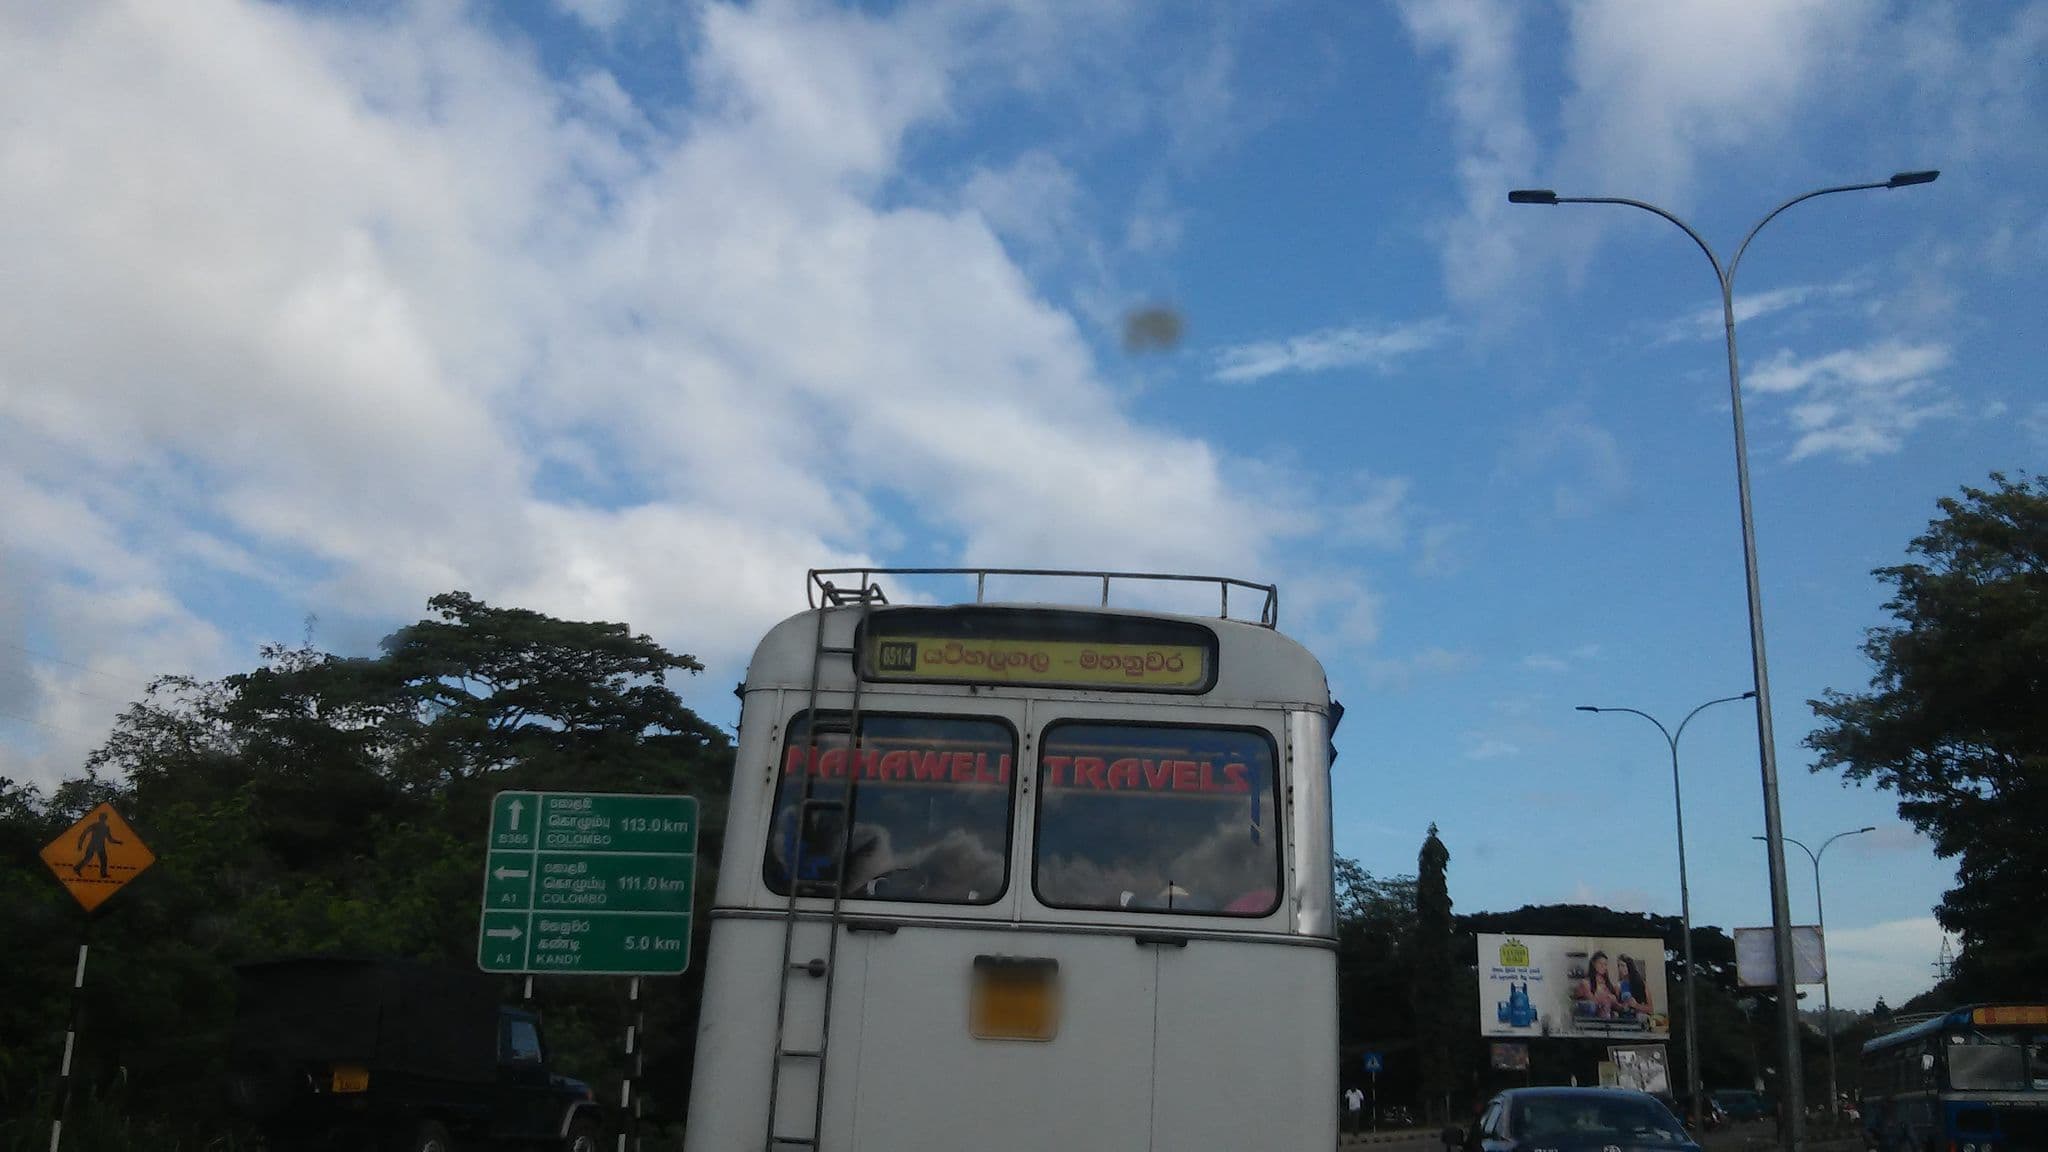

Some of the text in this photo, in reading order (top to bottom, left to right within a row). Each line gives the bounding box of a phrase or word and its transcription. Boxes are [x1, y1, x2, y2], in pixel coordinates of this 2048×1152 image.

[1079, 649, 1184, 677] මහනුවර
[1043, 755, 1250, 793] TRAVELS
[549, 814, 611, 830] கொழும்பு
[547, 834, 612, 845] COLOMBO
[543, 876, 608, 892] கொழும்பு
[501, 893, 517, 904] A1
[542, 893, 608, 904] COLOMBO
[624, 935, 681, 951] 5.0 km
[496, 952, 512, 964] A1
[535, 953, 582, 964] KANDY
